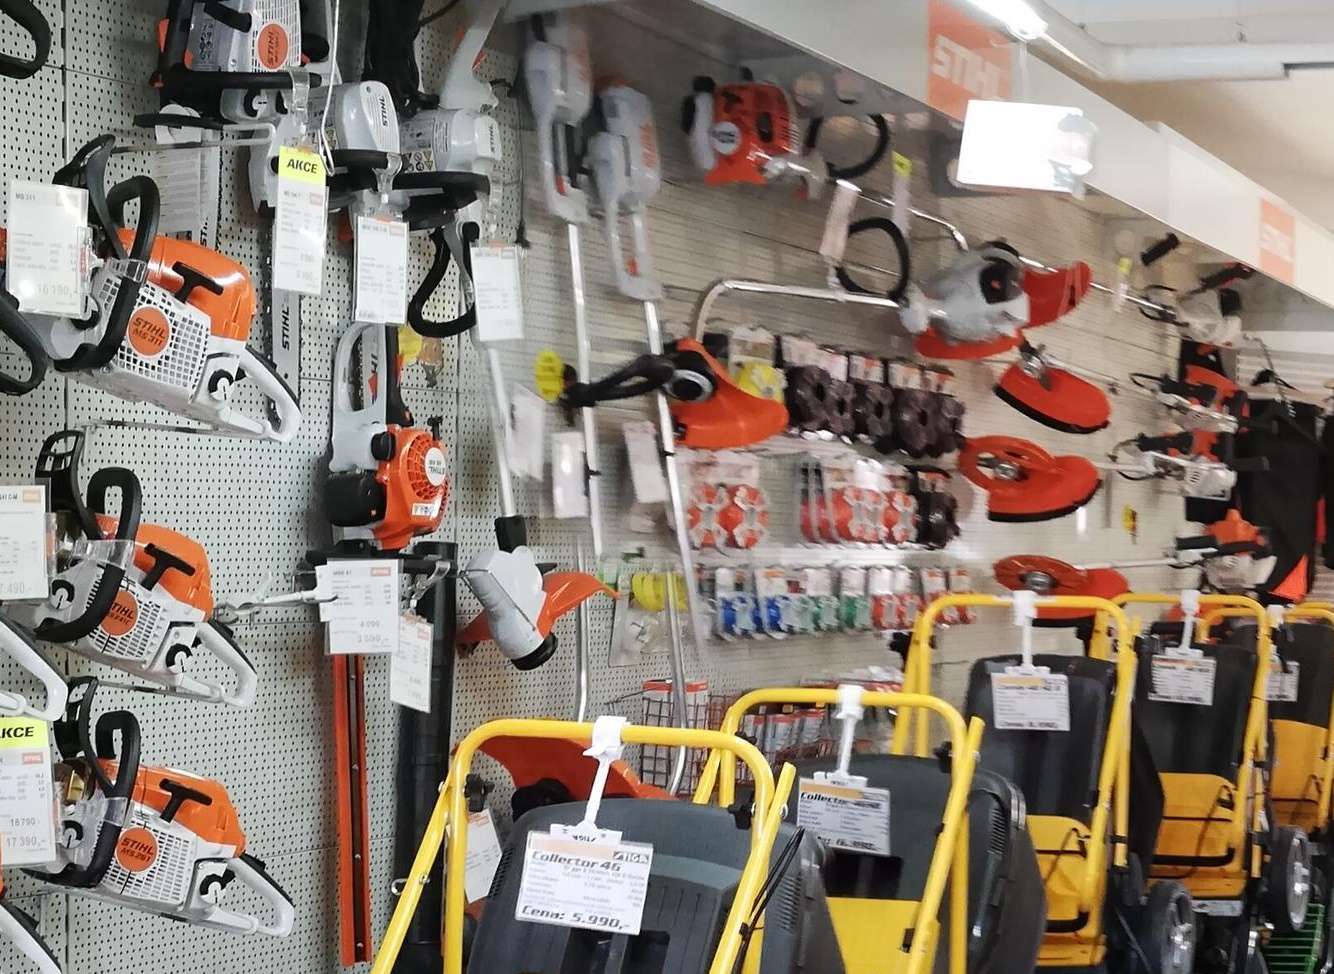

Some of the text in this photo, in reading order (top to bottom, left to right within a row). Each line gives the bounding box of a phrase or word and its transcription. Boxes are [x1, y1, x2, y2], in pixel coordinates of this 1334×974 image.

[380, 95, 389, 128] STIHL
[287, 158, 318, 174] AKCE
[133, 317, 167, 340] STIHL
[281, 305, 291, 351] STIHL
[121, 836, 155, 855] STIHL
[532, 851, 600, 869] Collector
[522, 905, 566, 920] Cena:
